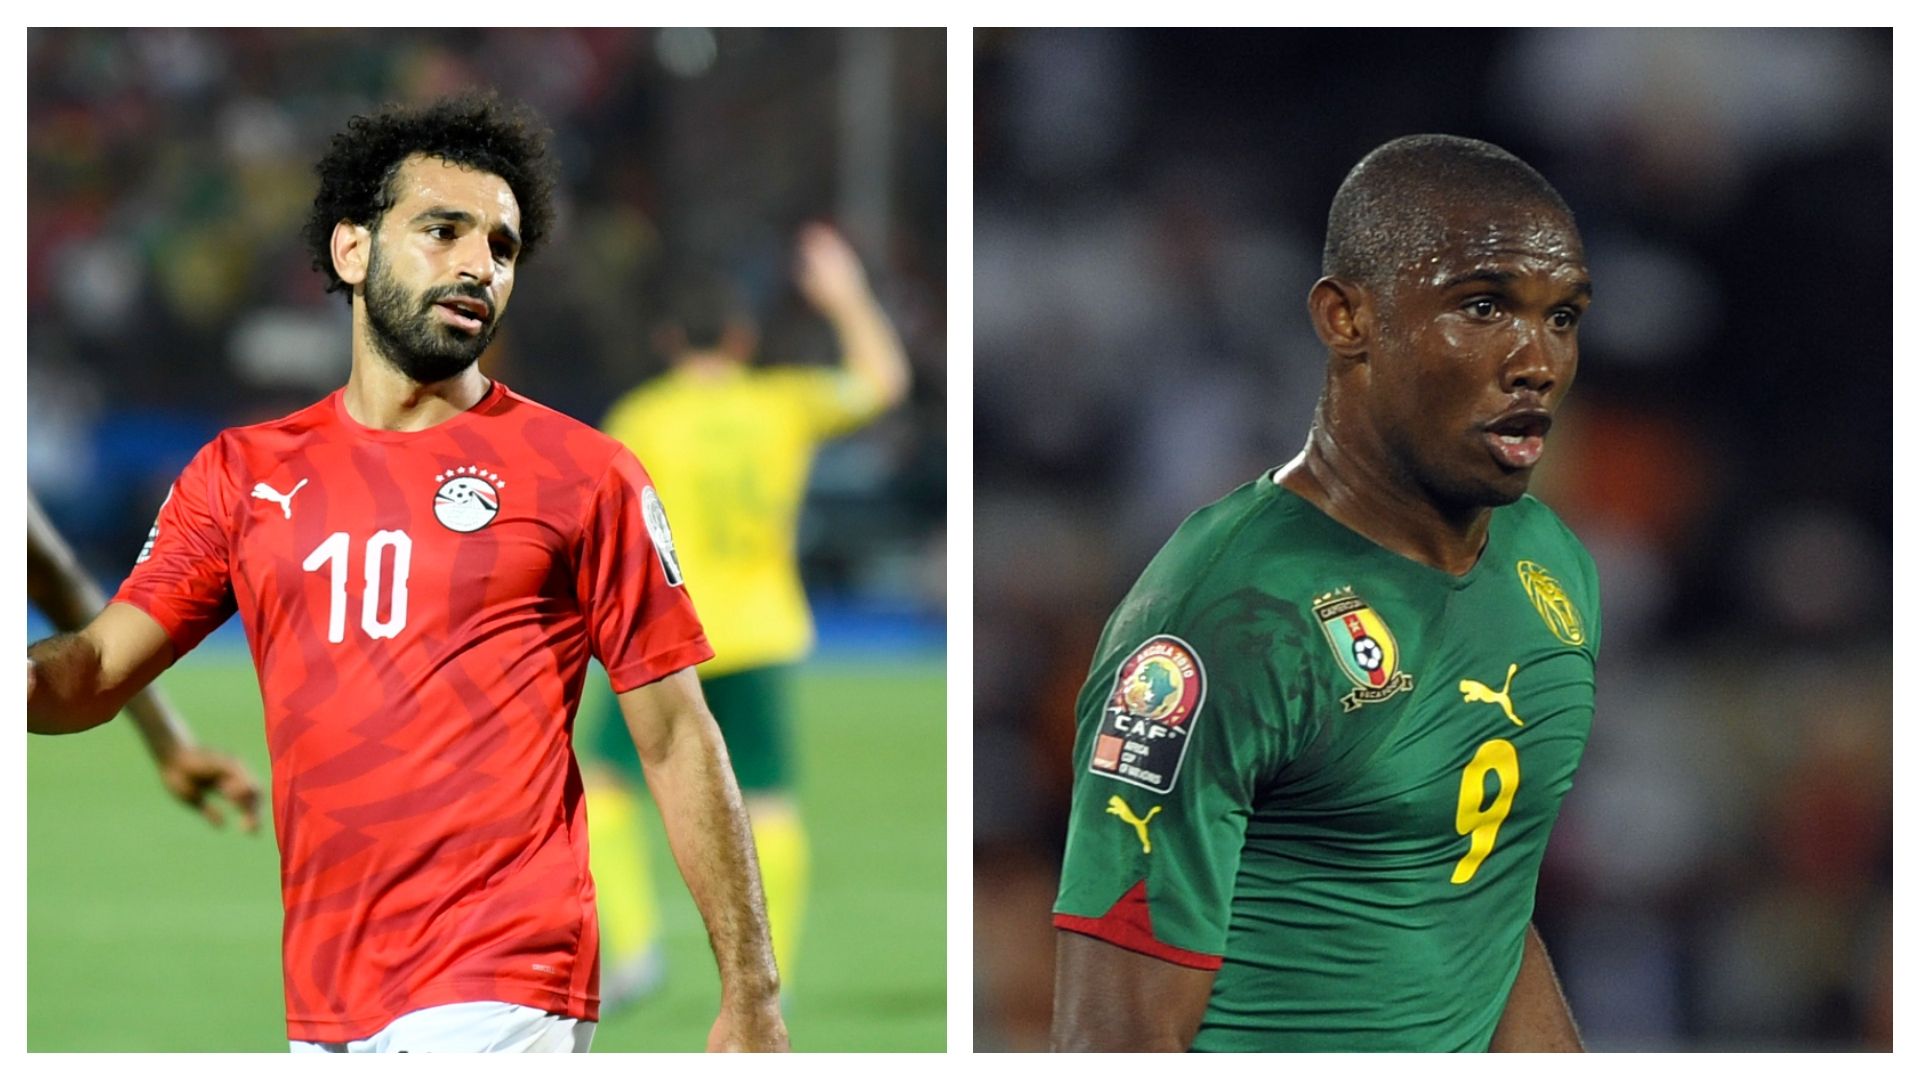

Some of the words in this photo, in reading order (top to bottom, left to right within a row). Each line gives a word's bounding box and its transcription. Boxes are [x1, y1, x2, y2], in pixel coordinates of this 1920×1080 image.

[302, 528, 413, 644] 10
[1173, 652, 1195, 678] 2010
[1114, 715, 1168, 739] CAF
[1450, 738, 1521, 886] 9
